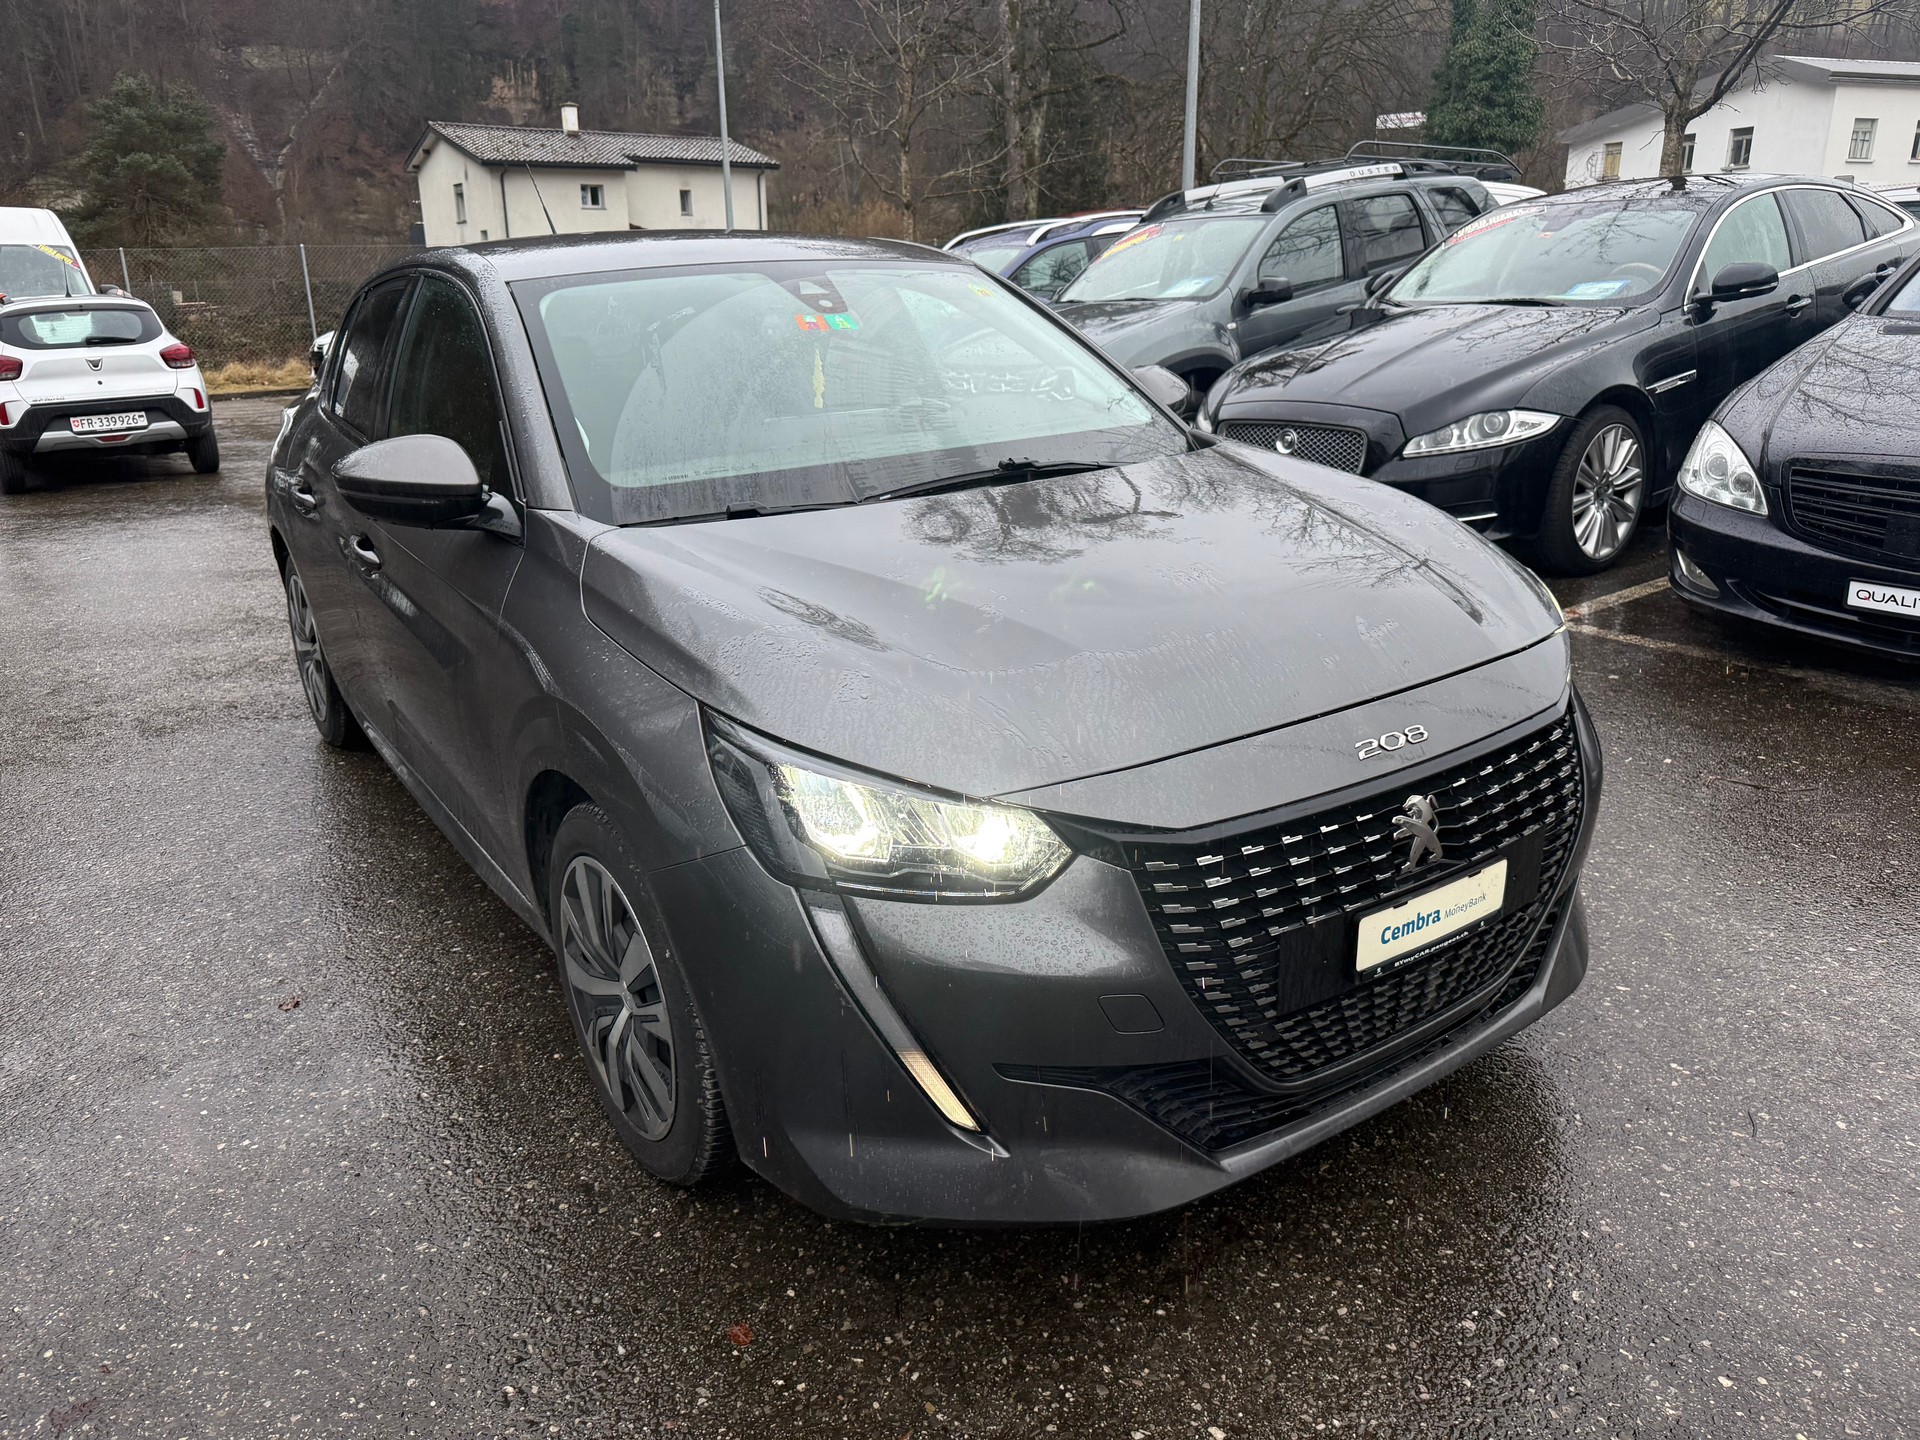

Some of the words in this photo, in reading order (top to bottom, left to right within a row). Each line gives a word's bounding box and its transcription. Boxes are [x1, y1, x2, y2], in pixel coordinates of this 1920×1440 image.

[1349, 165, 1399, 178] DUSTER
[1856, 589, 1920, 609] QUALI
[1354, 724, 1429, 760] 208
[1380, 909, 1441, 945] Cembra
[1443, 893, 1487, 920] MoneyBank
